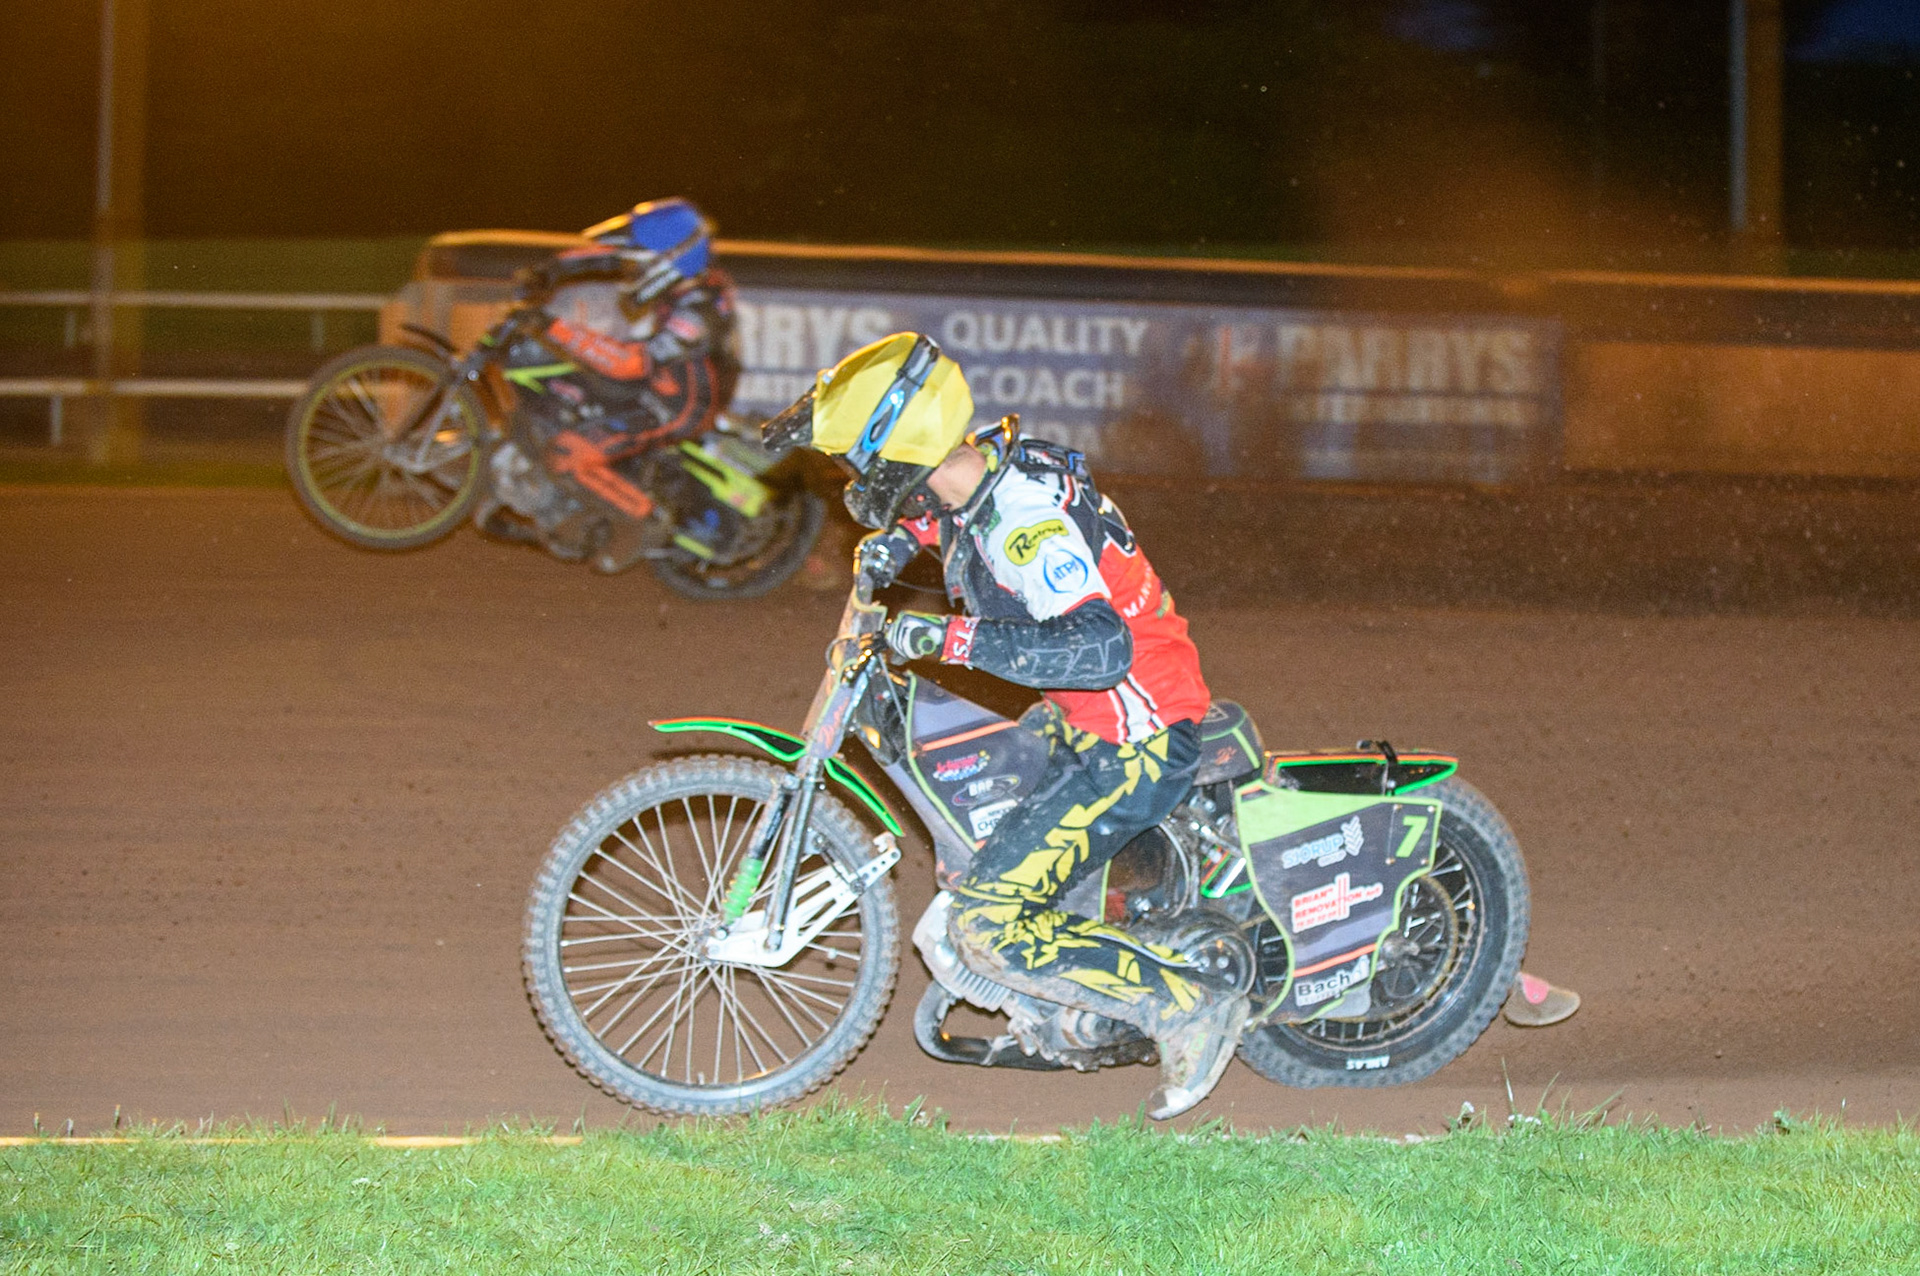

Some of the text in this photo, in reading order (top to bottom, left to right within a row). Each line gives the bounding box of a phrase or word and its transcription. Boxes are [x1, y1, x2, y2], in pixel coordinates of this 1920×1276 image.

[943, 310, 1149, 354] QUALITY
[966, 364, 1126, 409] COACH
[1396, 815, 1429, 858] 7
